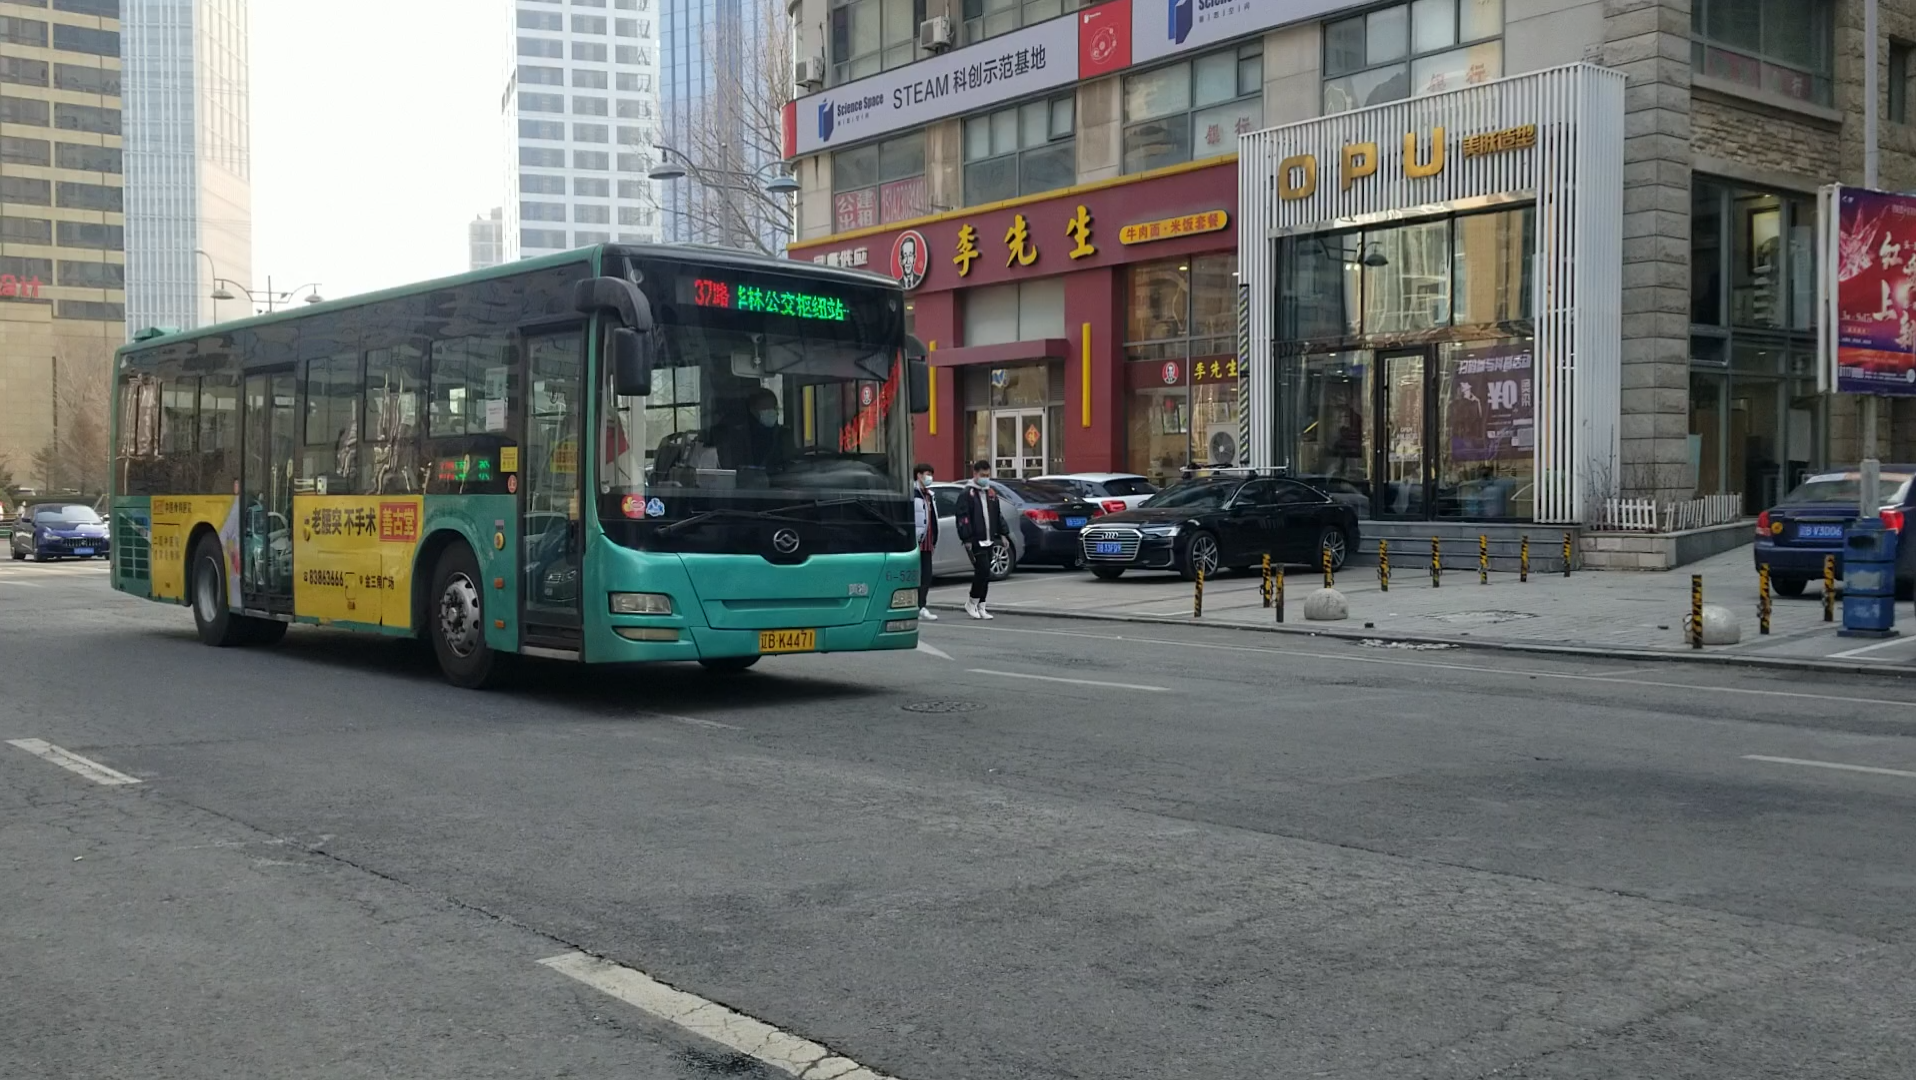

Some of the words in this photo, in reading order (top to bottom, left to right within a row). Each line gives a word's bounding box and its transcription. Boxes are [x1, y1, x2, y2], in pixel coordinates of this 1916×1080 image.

[893, 75, 949, 110] STEAM
[953, 44, 1046, 94] 科创示范基地
[837, 98, 863, 117] Science
[864, 93, 884, 111] Space
[1278, 127, 1444, 200] OPU
[953, 205, 1095, 277] 李先生
[694, 279, 731, 308] 37路
[1194, 358, 1237, 380] 李先生
[312, 507, 342, 536] 老腰突
[344, 507, 376, 537] 不手术
[382, 507, 415, 537] 善古堂
[309, 569, 344, 587] 83863666
[761, 631, 814, 649] 辽B·K4471
